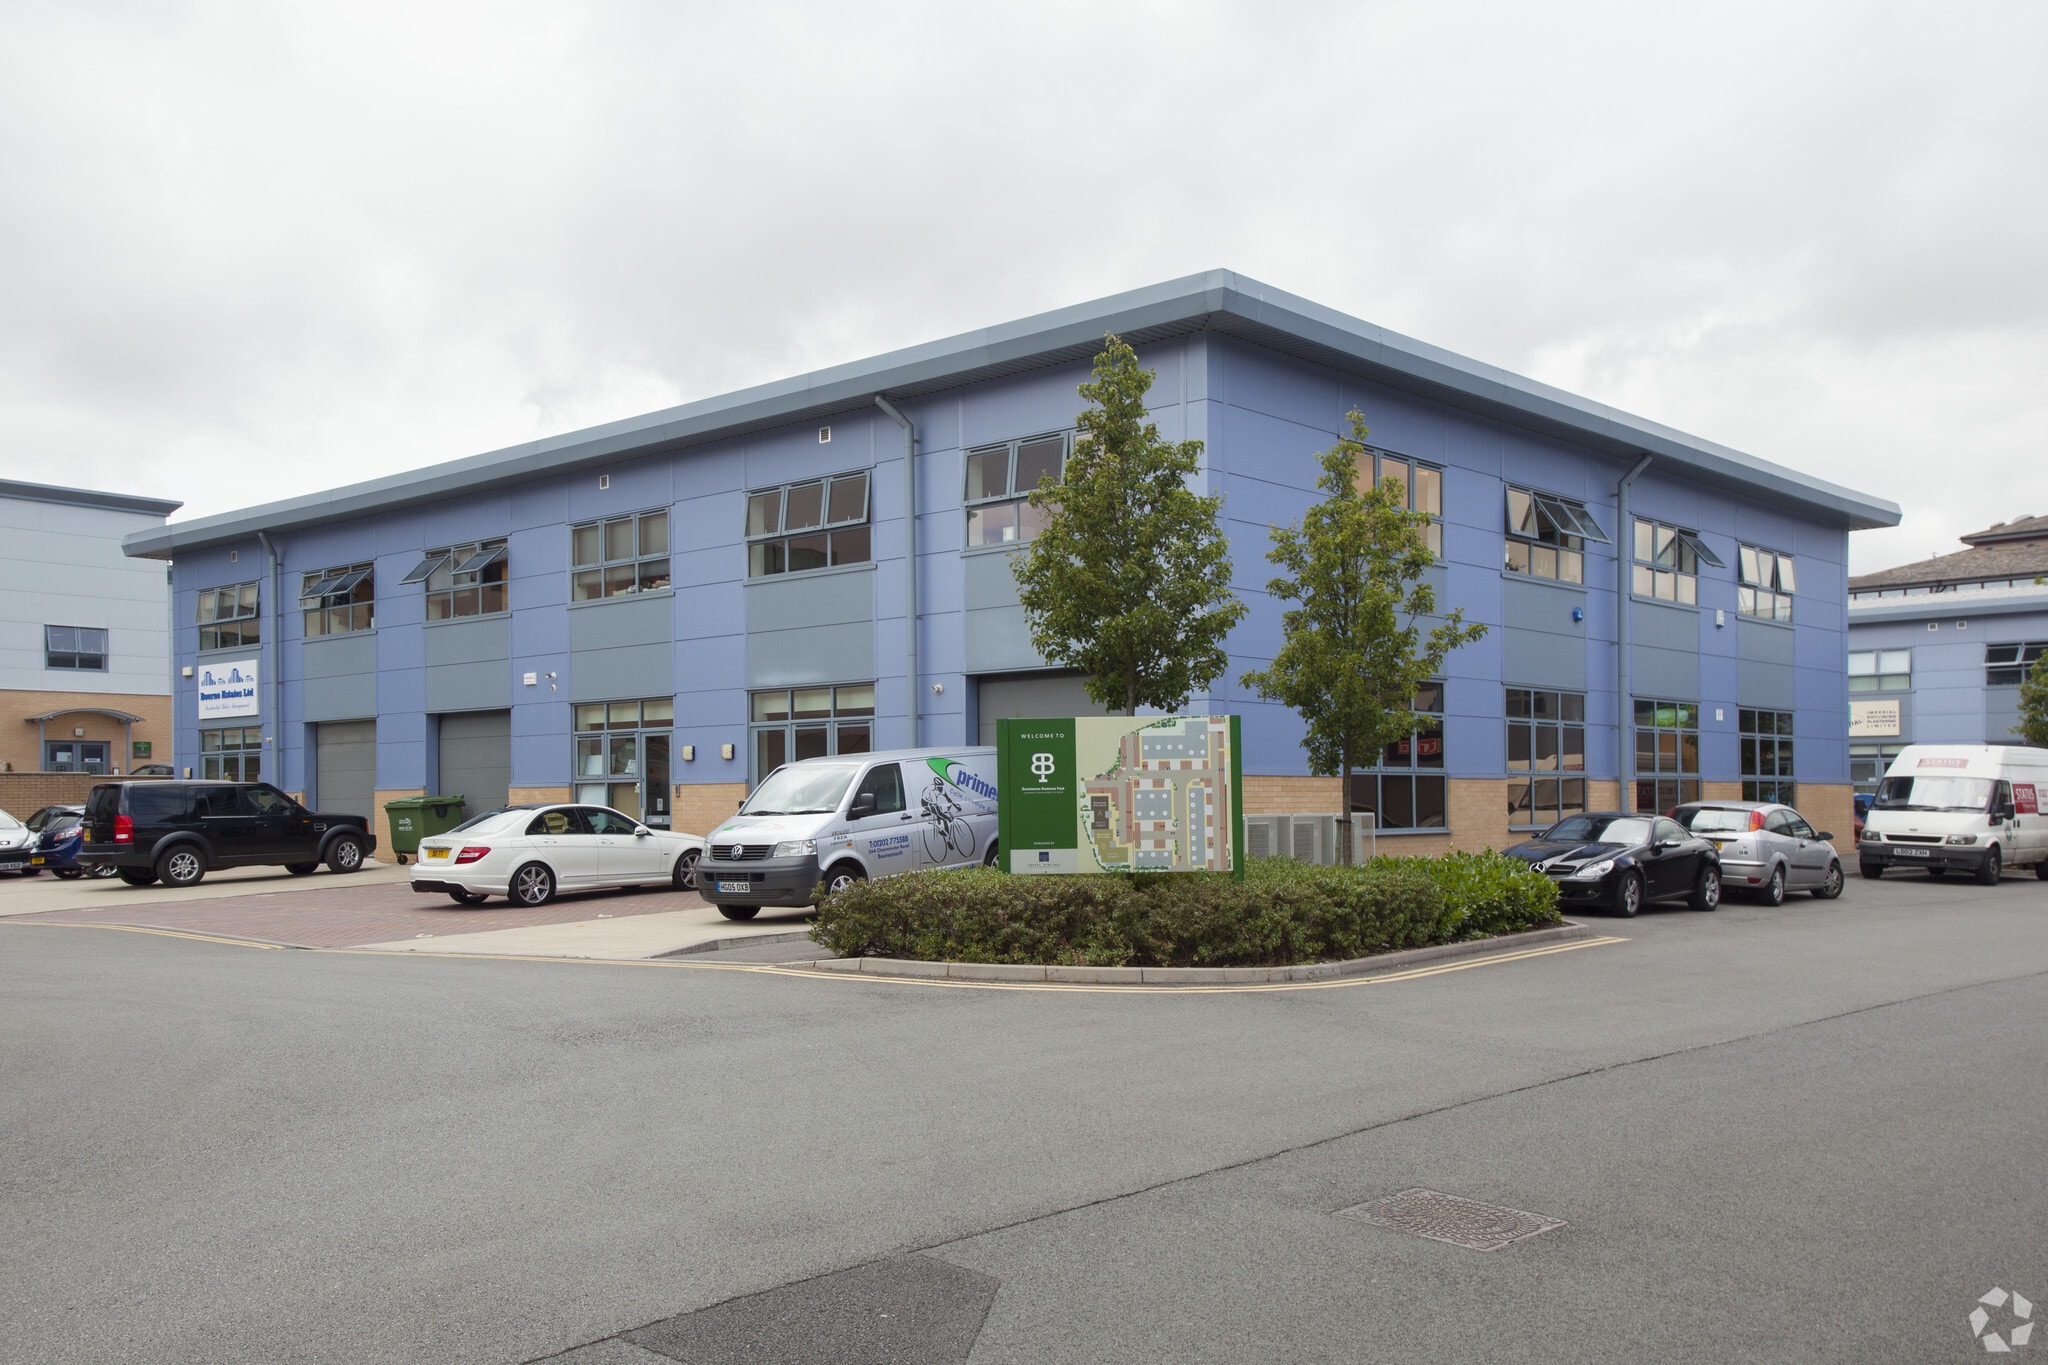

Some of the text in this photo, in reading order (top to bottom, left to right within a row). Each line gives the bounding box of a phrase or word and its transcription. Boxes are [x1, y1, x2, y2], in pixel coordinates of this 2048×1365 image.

[222, 690, 242, 698] Estates
[243, 687, 254, 697] Ltd
[956, 769, 998, 802] prime
[2015, 788, 2035, 800] STATUS
